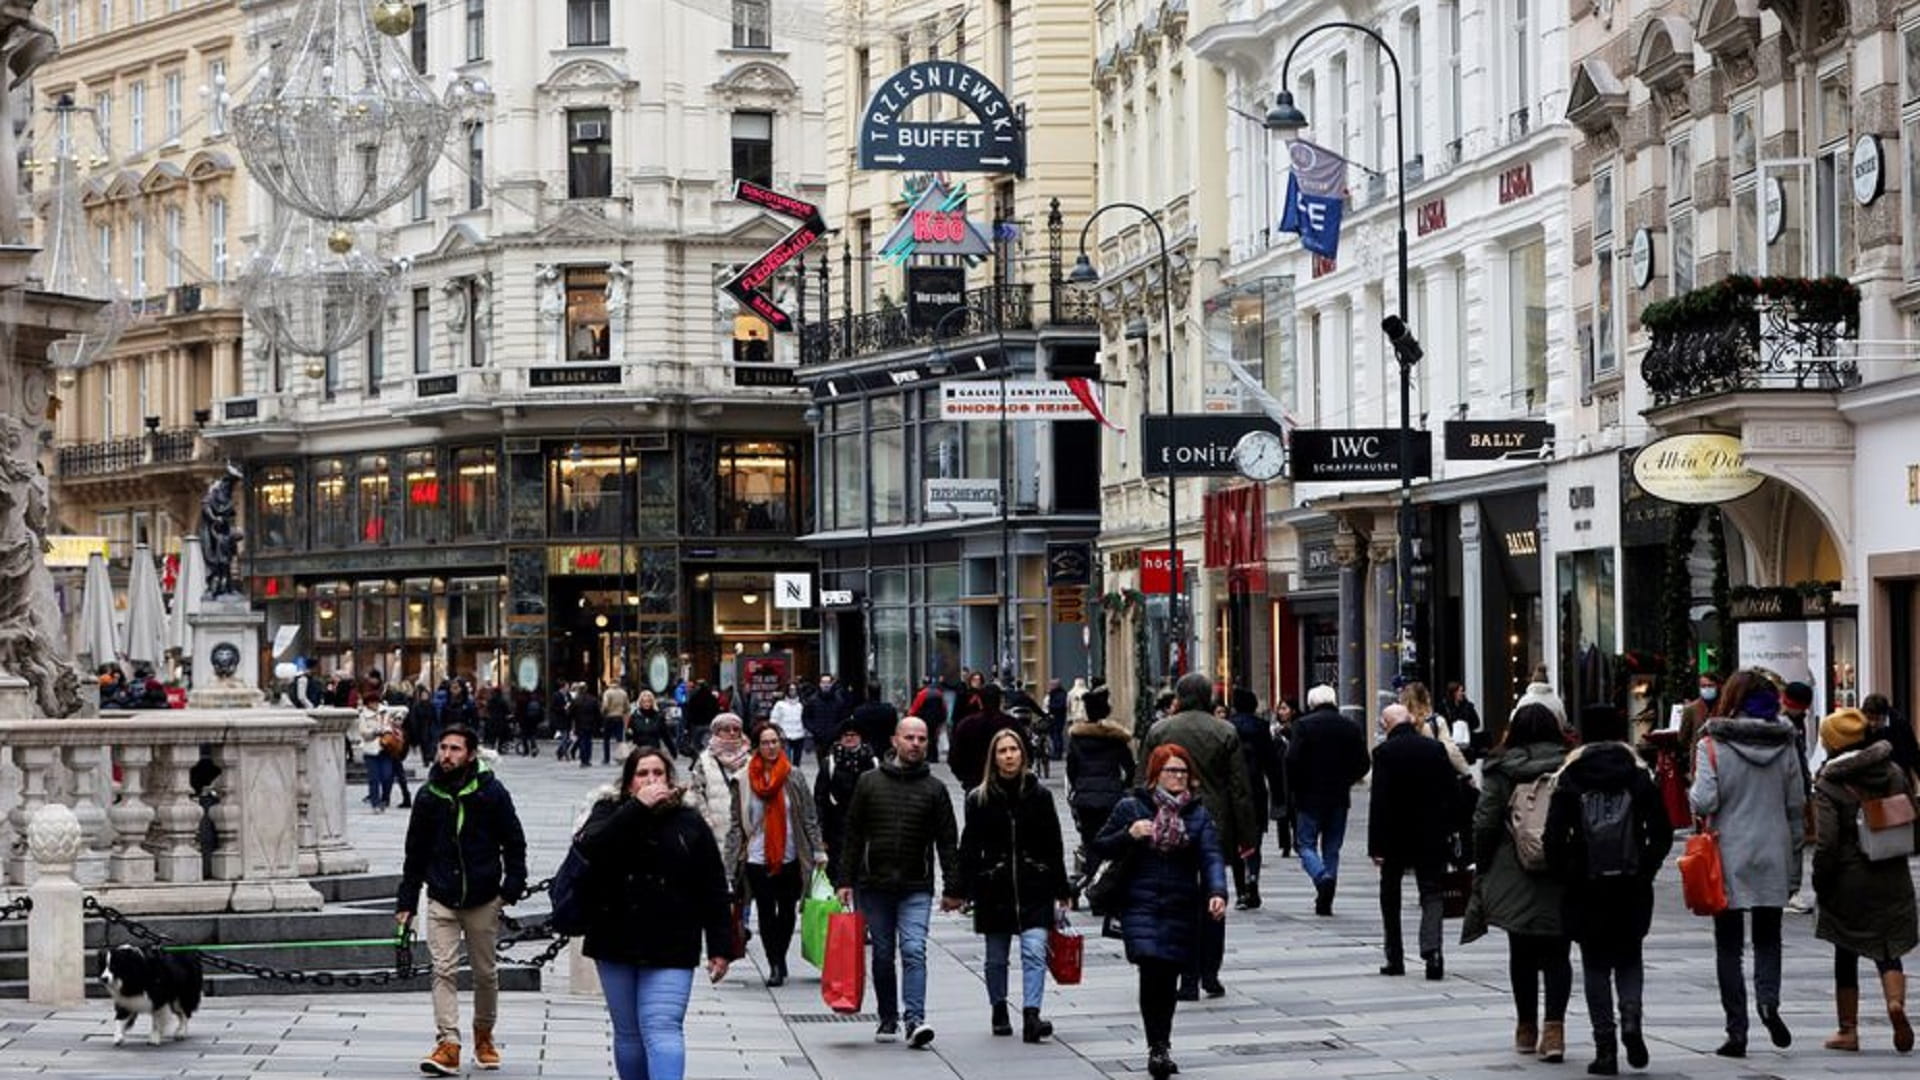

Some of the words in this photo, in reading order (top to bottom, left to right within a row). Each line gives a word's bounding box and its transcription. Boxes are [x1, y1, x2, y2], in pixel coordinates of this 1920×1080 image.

[898, 128, 985, 149] BUFFET
[1499, 162, 1534, 205] LISKA
[1417, 197, 1447, 237] LISKA
[741, 230, 816, 290] FLEDERMAUS
[958, 389, 1002, 397] GALERI
[1010, 389, 1046, 397] ERNST
[1330, 436, 1380, 459] IWC
[1469, 433, 1526, 447] BALLY
[1312, 462, 1398, 473] SCHAFFHAUSEN
[1704, 450, 1745, 469] Den
[1505, 530, 1537, 556] BALLY
